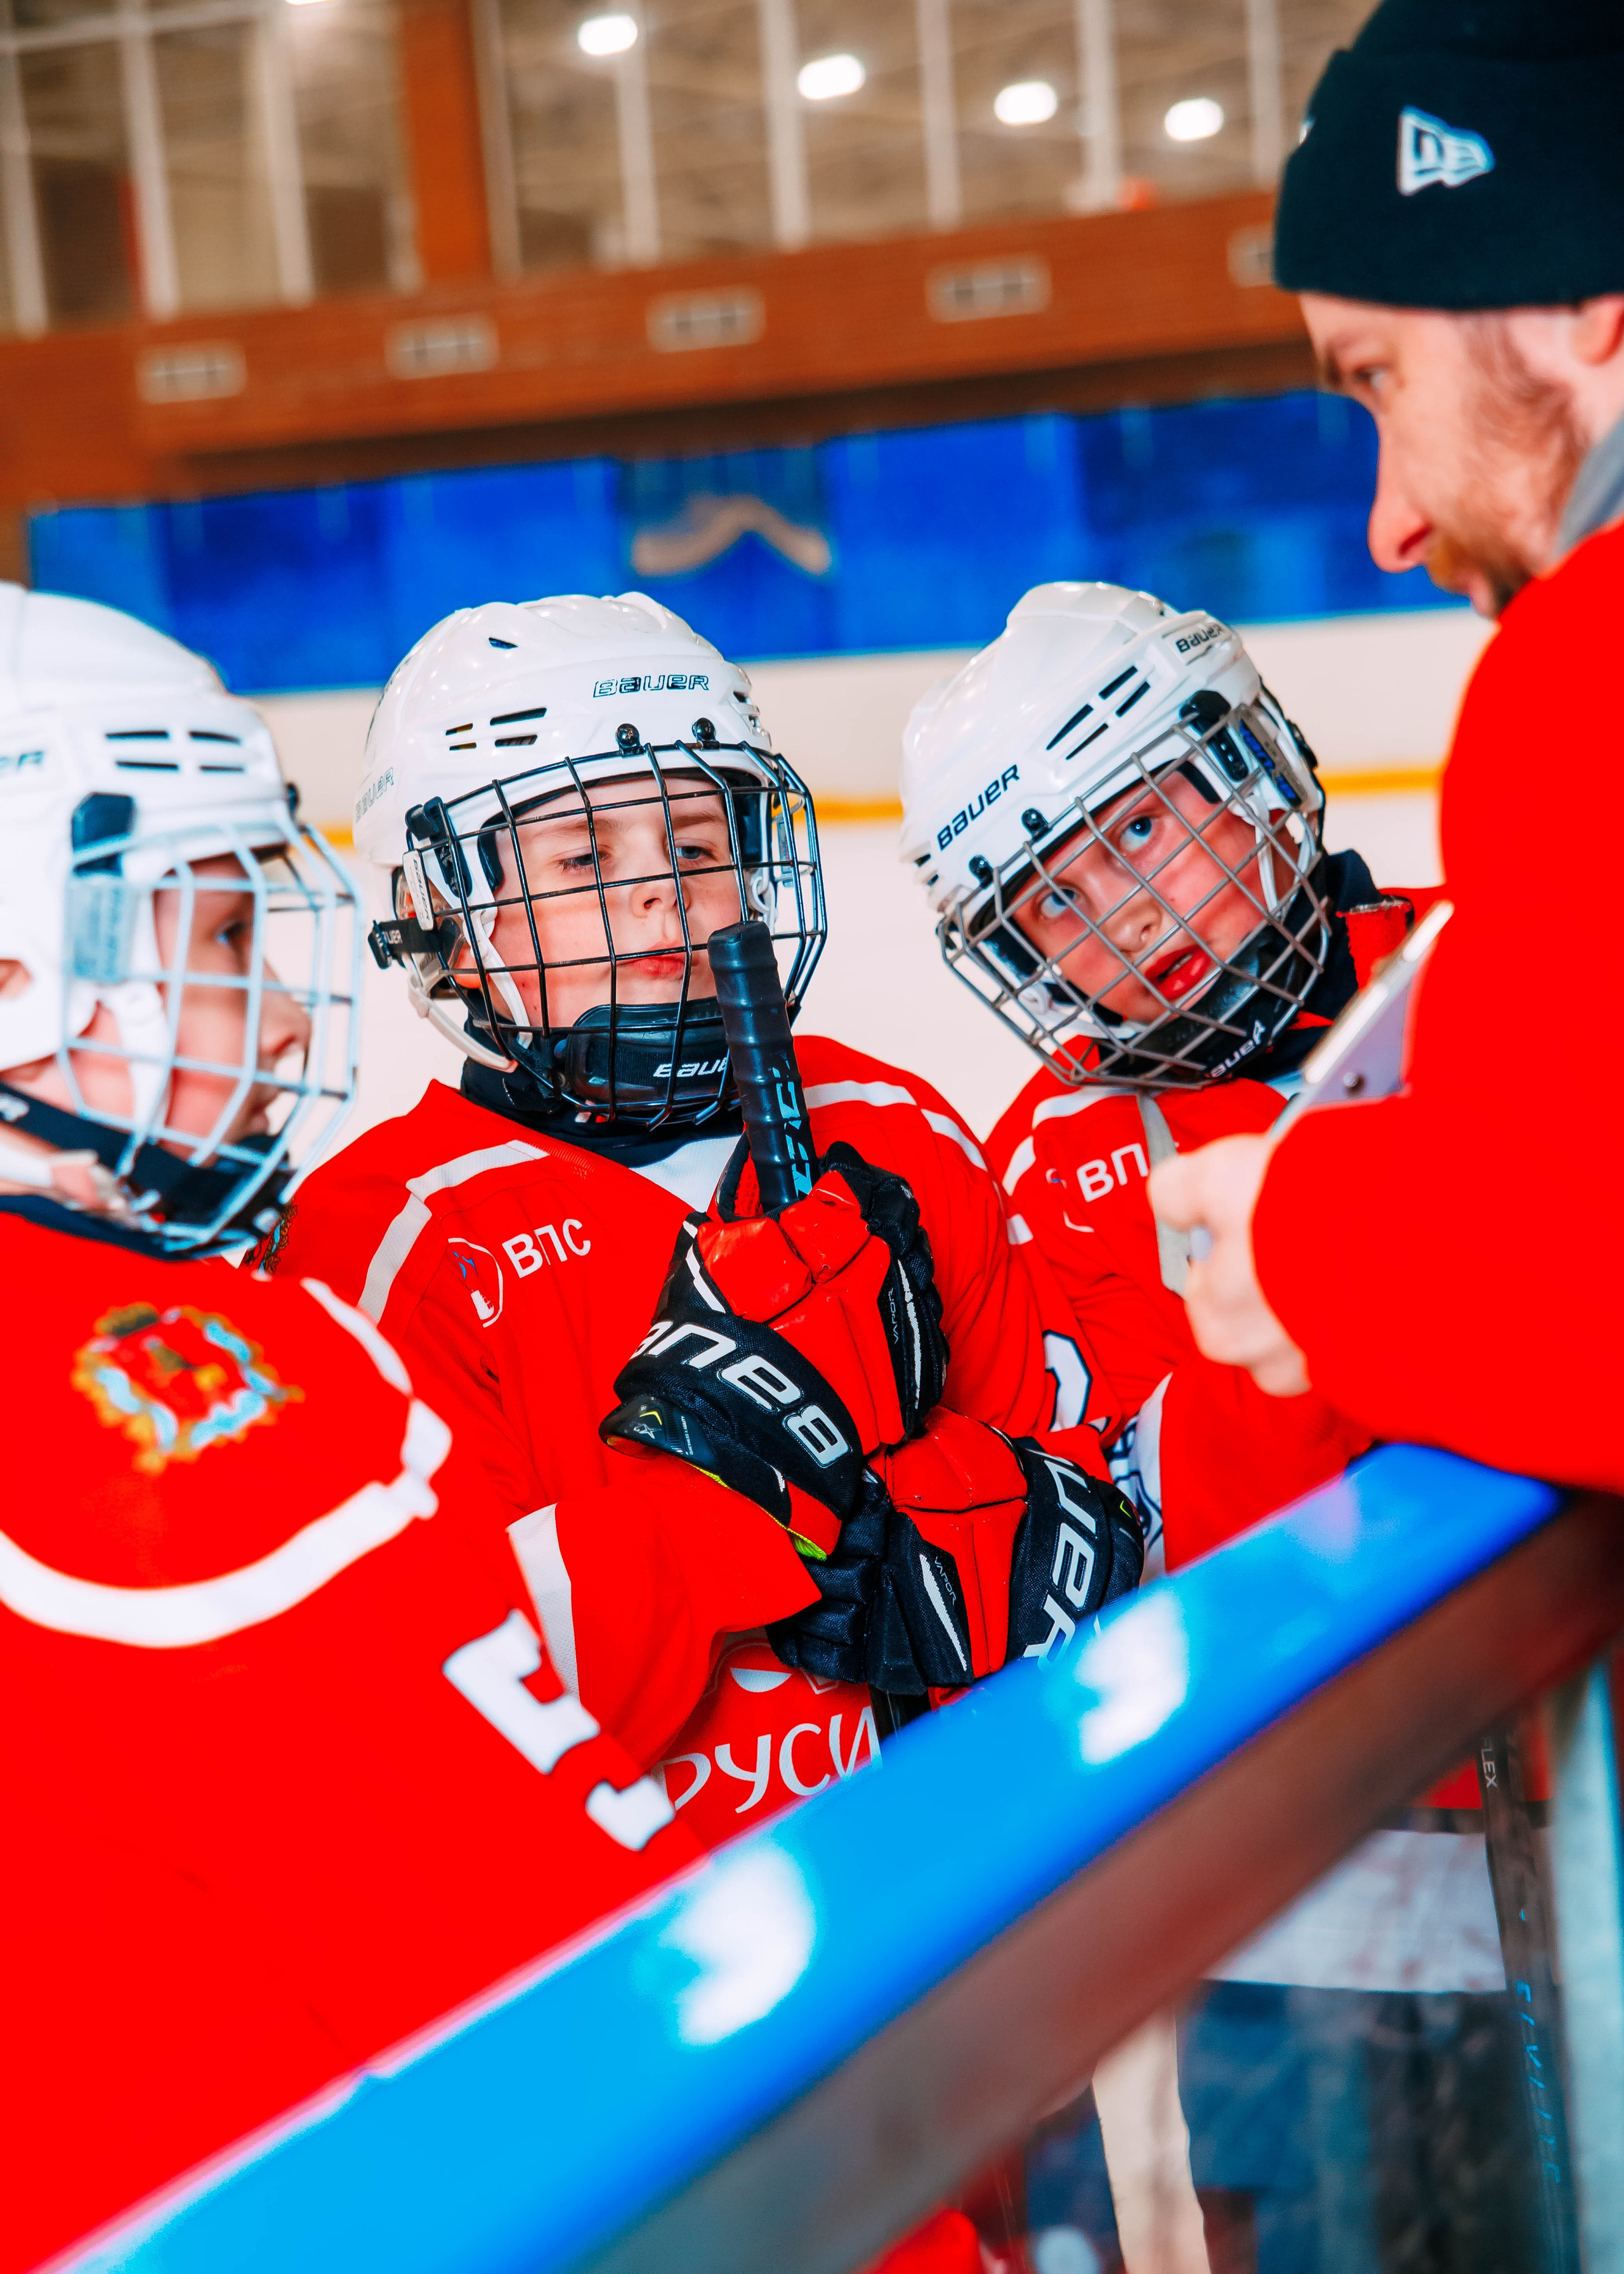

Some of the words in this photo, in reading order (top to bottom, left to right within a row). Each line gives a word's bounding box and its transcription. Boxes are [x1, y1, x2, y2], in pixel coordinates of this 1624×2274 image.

[593, 674, 709, 698] BAUER
[355, 766, 394, 823] BAUER
[937, 764, 1020, 851] BAUER
[1210, 1019, 1266, 1077] AUER
[1077, 1143, 1149, 1200] ВП
[502, 1218, 591, 1278] ВПС
[888, 1287, 899, 1344] VAPOR
[934, 1555, 957, 1605] VAPOR
